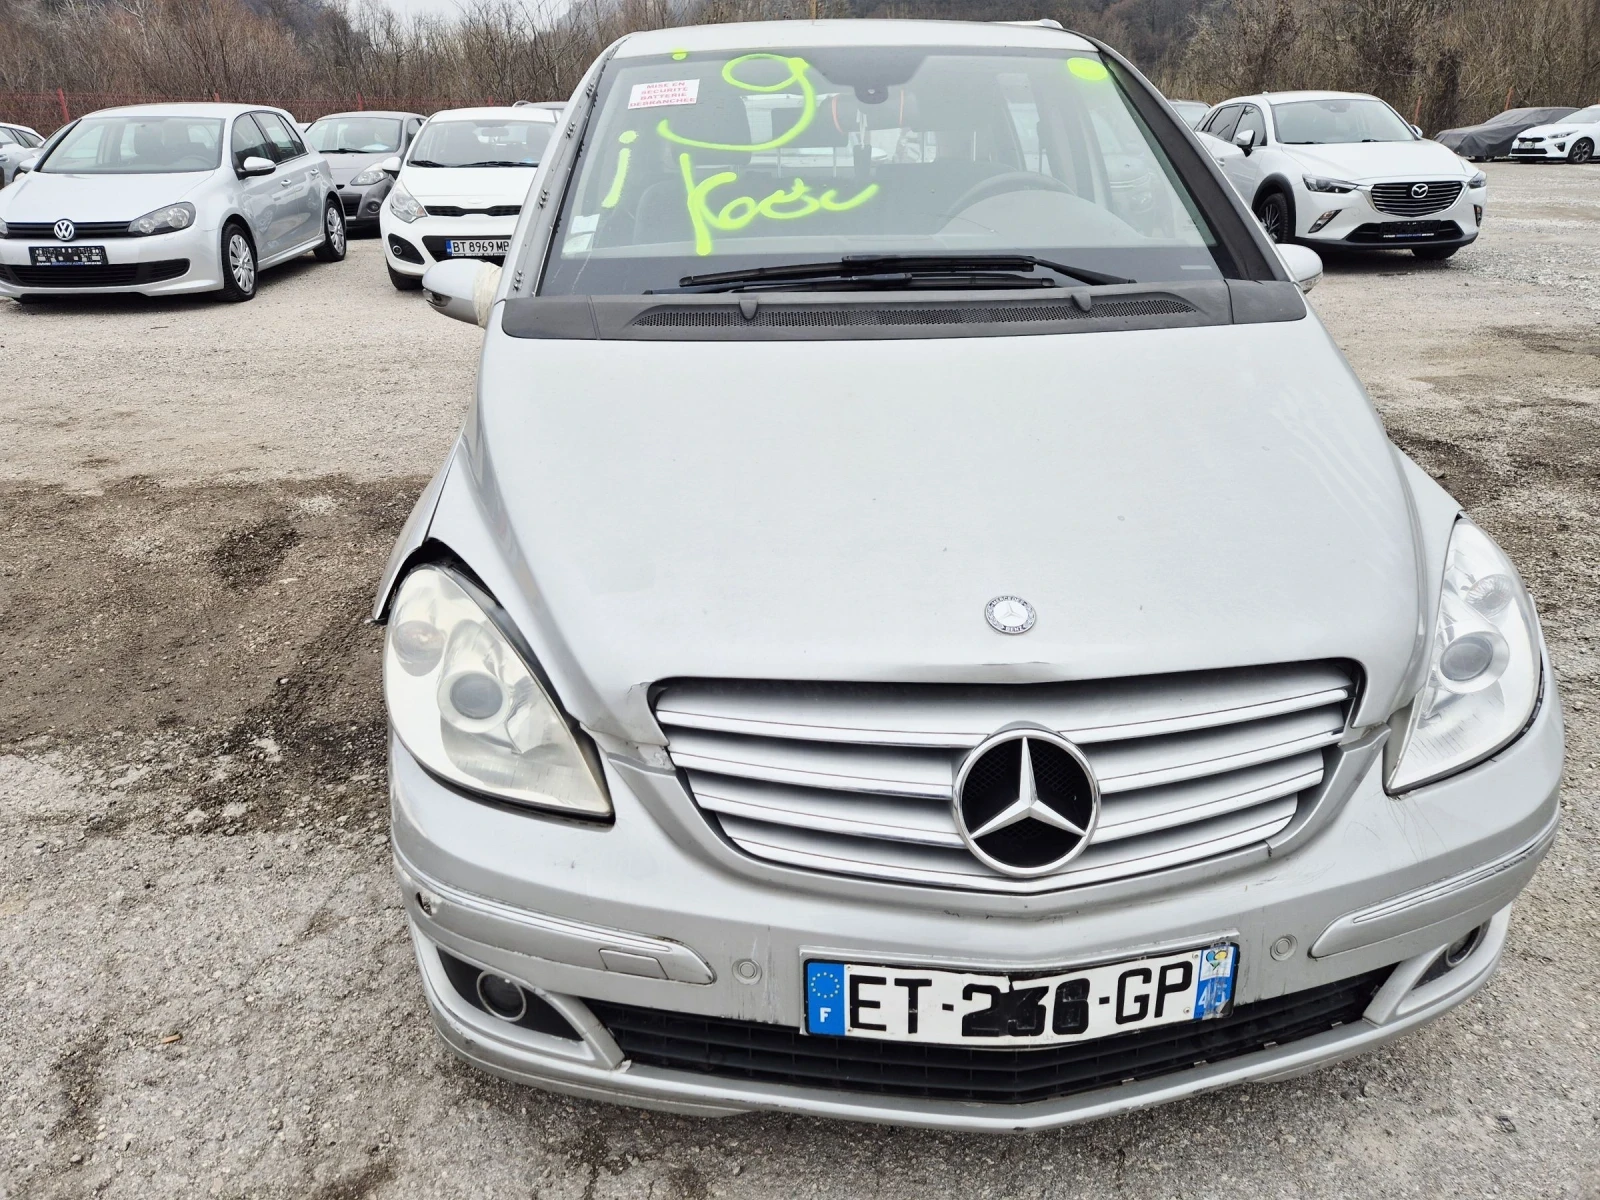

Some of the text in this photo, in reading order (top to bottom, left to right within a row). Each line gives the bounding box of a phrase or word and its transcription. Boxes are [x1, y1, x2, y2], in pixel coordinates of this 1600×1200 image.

[453, 241, 466, 252] BT
[468, 241, 494, 252] 8969
[819, 1006, 832, 1023] F
